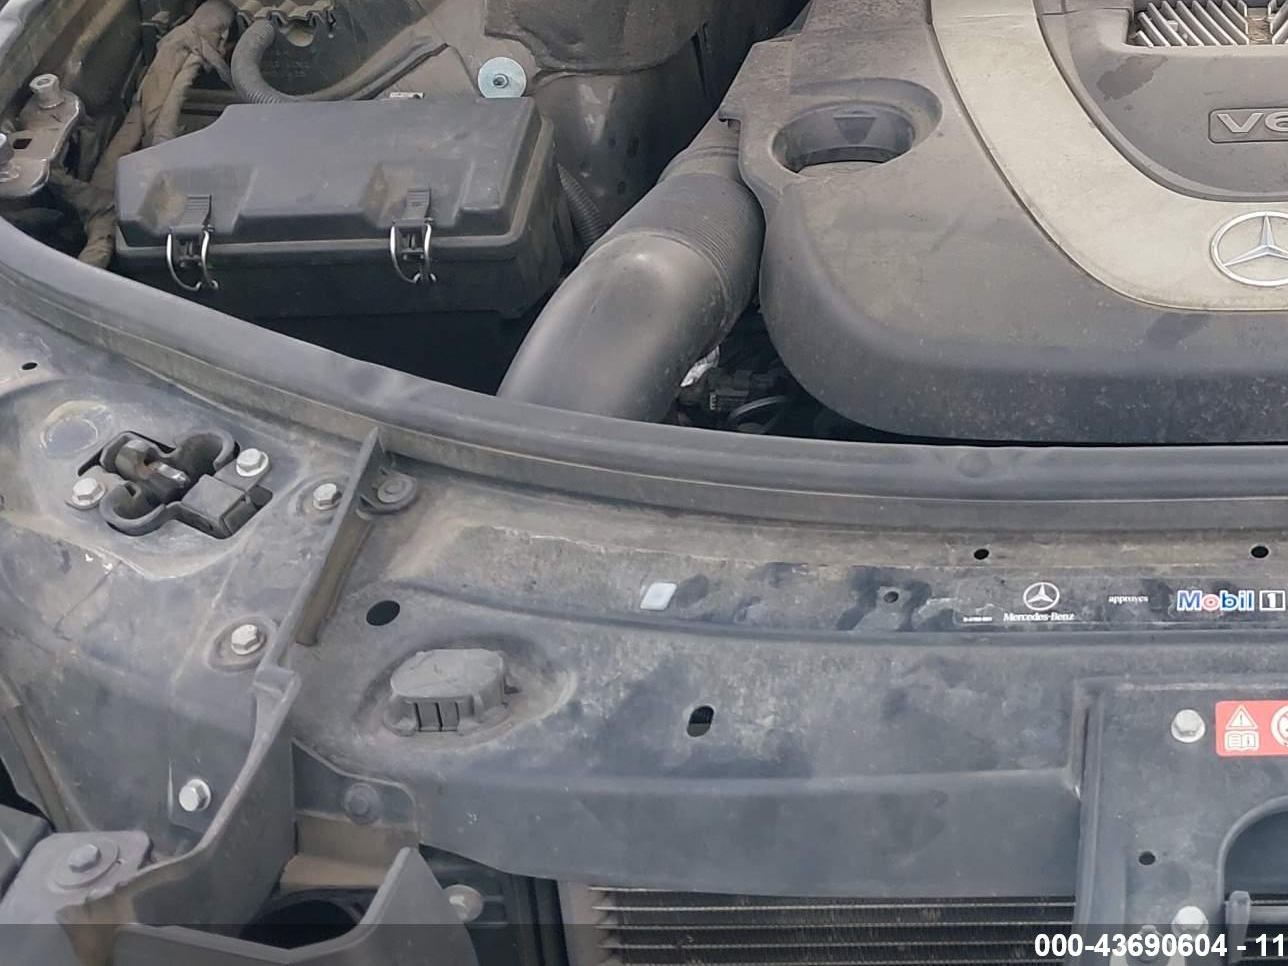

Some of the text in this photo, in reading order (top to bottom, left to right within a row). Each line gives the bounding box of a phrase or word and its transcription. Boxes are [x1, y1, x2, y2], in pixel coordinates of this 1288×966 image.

[1108, 595, 1149, 604] approves
[1177, 590, 1255, 612] Mobil
[1003, 612, 1075, 622] Mercedes-Benz
